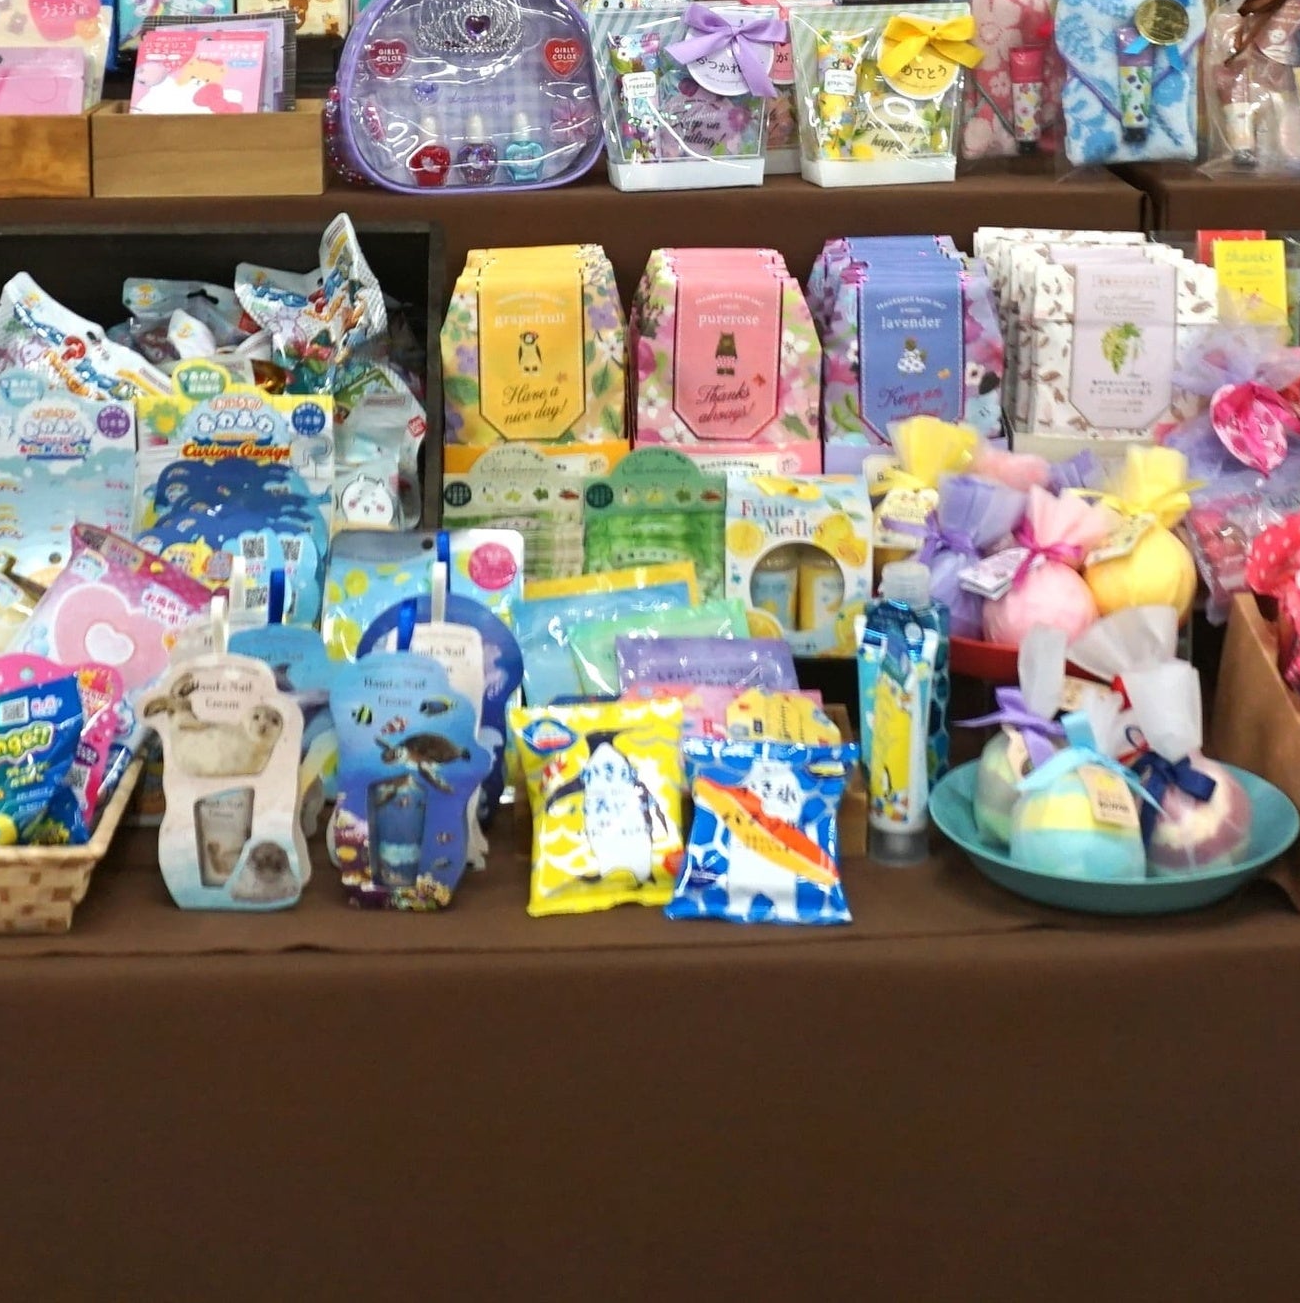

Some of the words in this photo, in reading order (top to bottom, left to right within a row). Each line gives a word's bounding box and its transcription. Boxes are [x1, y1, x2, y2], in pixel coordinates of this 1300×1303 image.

[494, 311, 566, 328] grapefruit
[699, 312, 760, 328] purerose
[881, 314, 941, 330] lavender
[503, 384, 547, 405] Have
[550, 387, 559, 397] a
[697, 381, 750, 404] Thanks
[504, 409, 531, 427] nice
[183, 441, 237, 458] Curious
